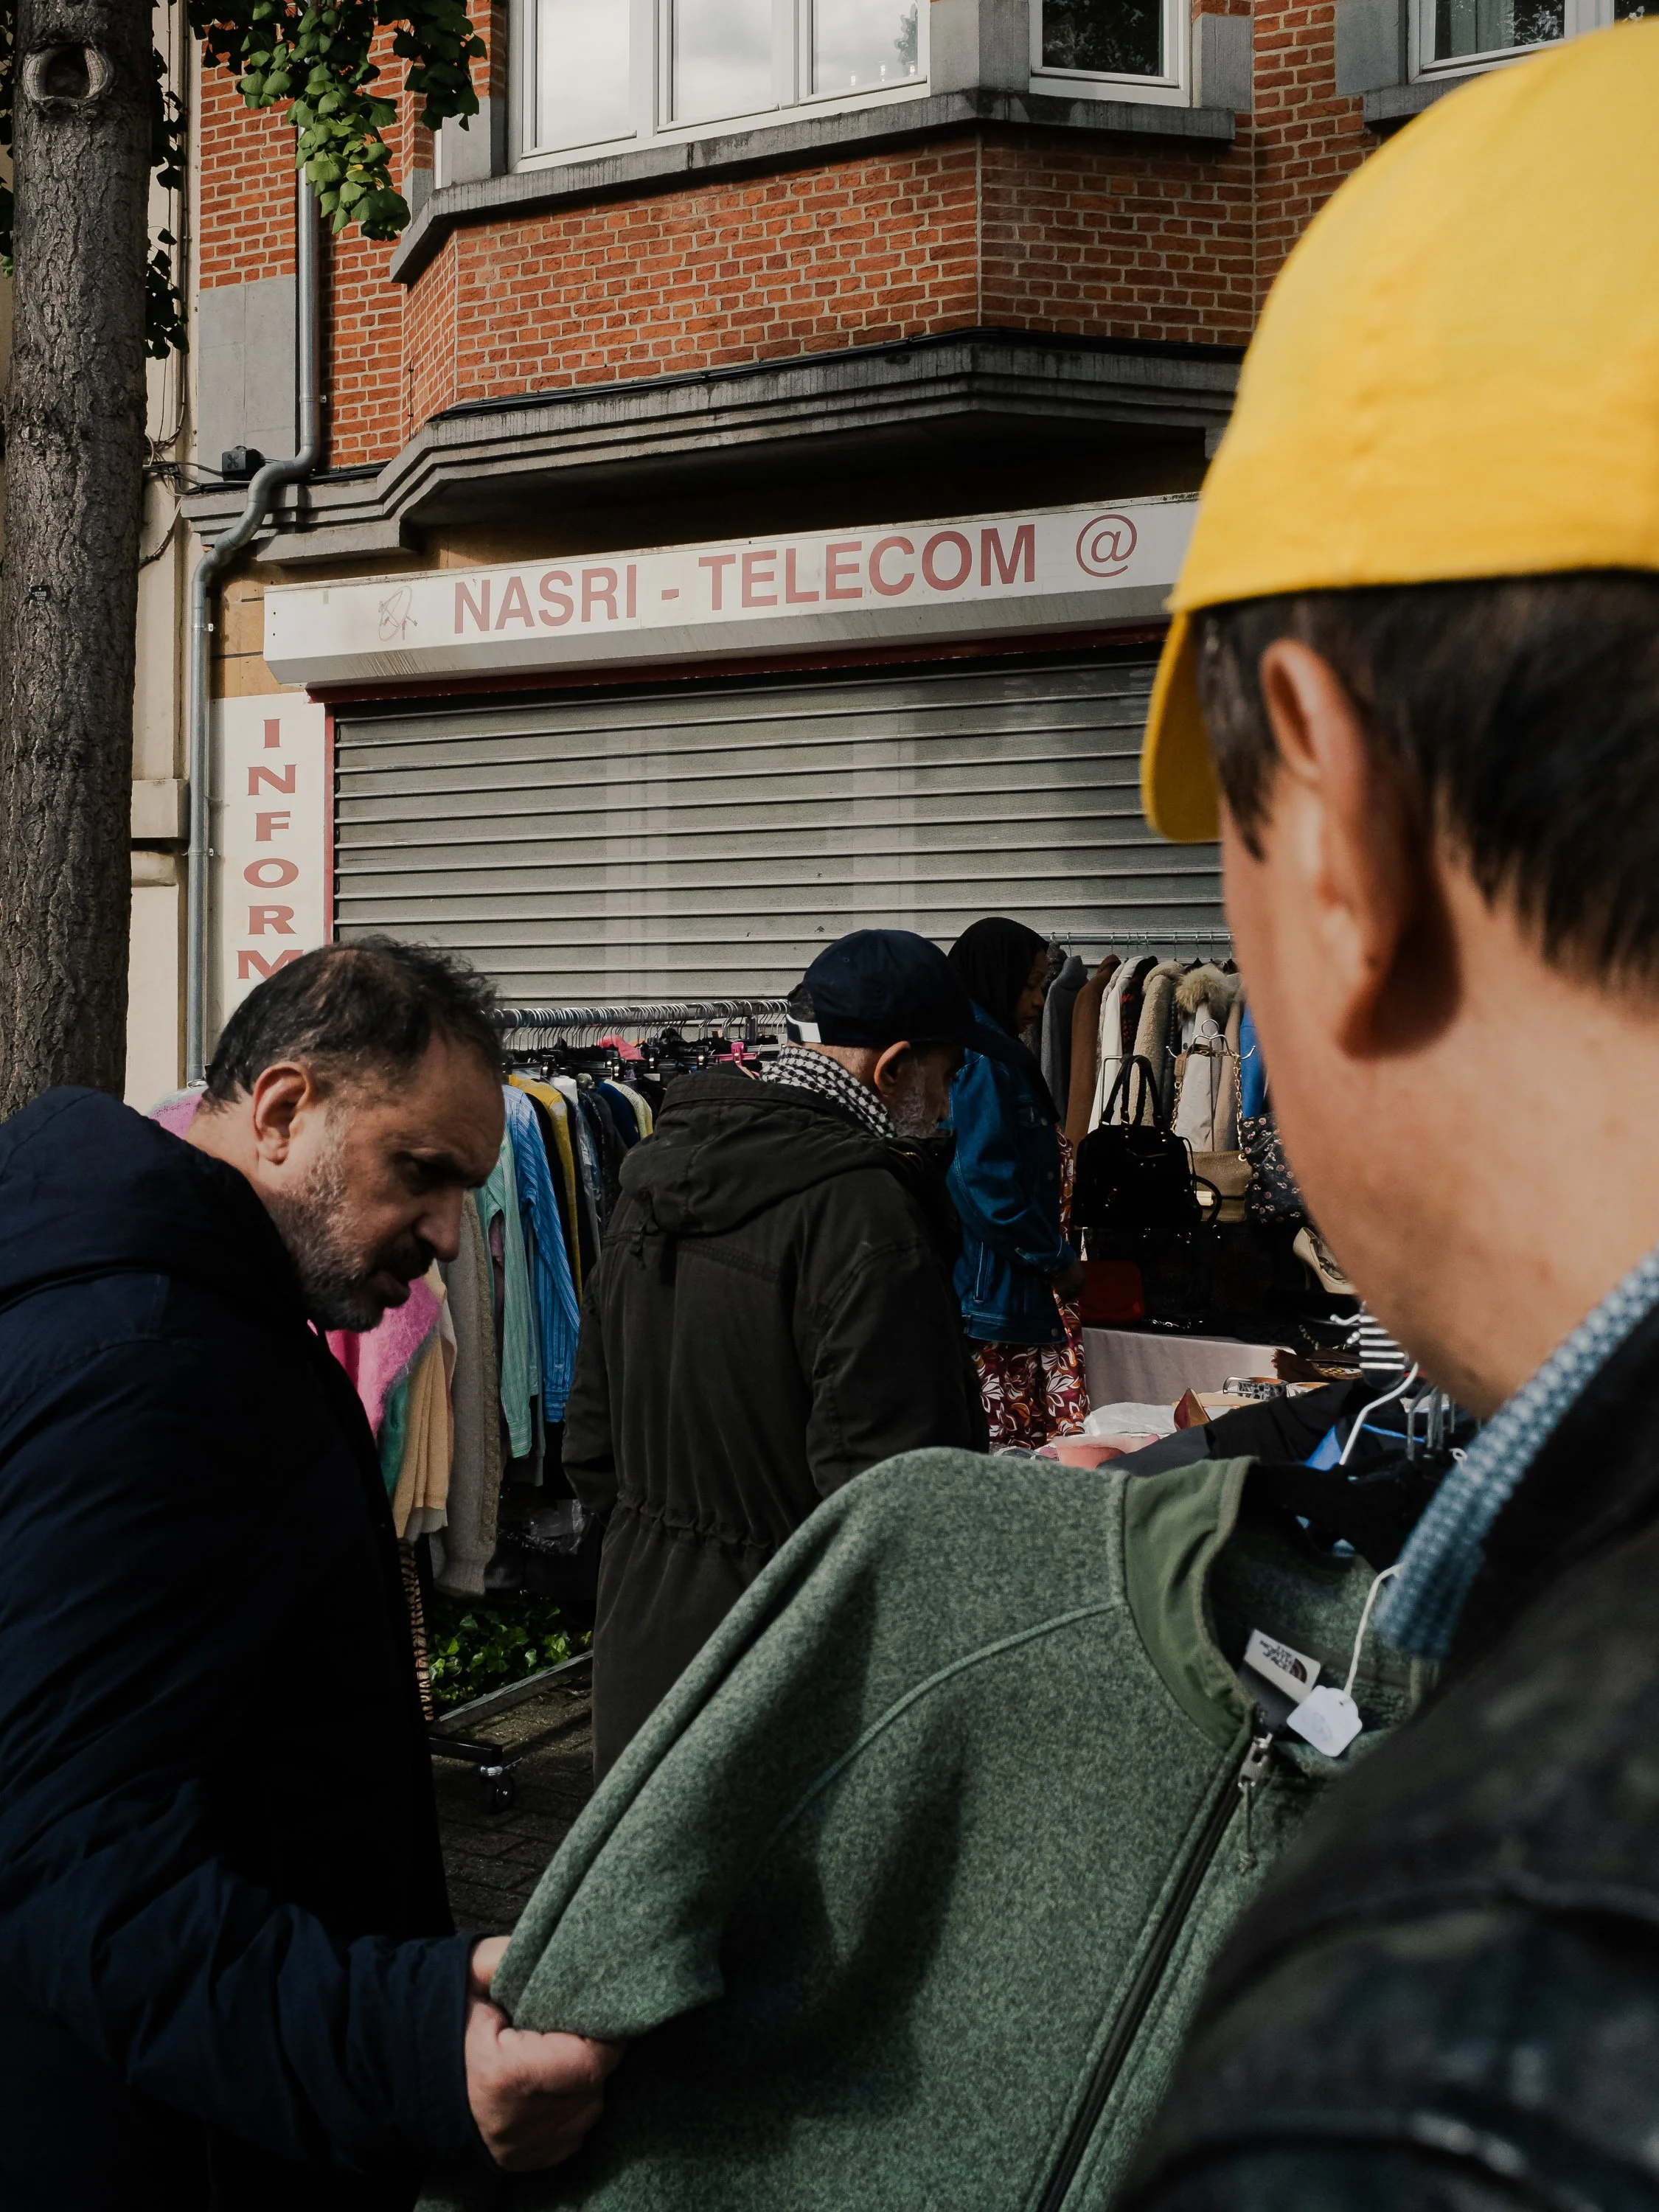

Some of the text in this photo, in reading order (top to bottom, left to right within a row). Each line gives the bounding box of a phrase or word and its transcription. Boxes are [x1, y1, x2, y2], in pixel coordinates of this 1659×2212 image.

[454, 564, 636, 634] NASRI
[698, 524, 1035, 611] TELECOM
[1076, 514, 1138, 578] @
